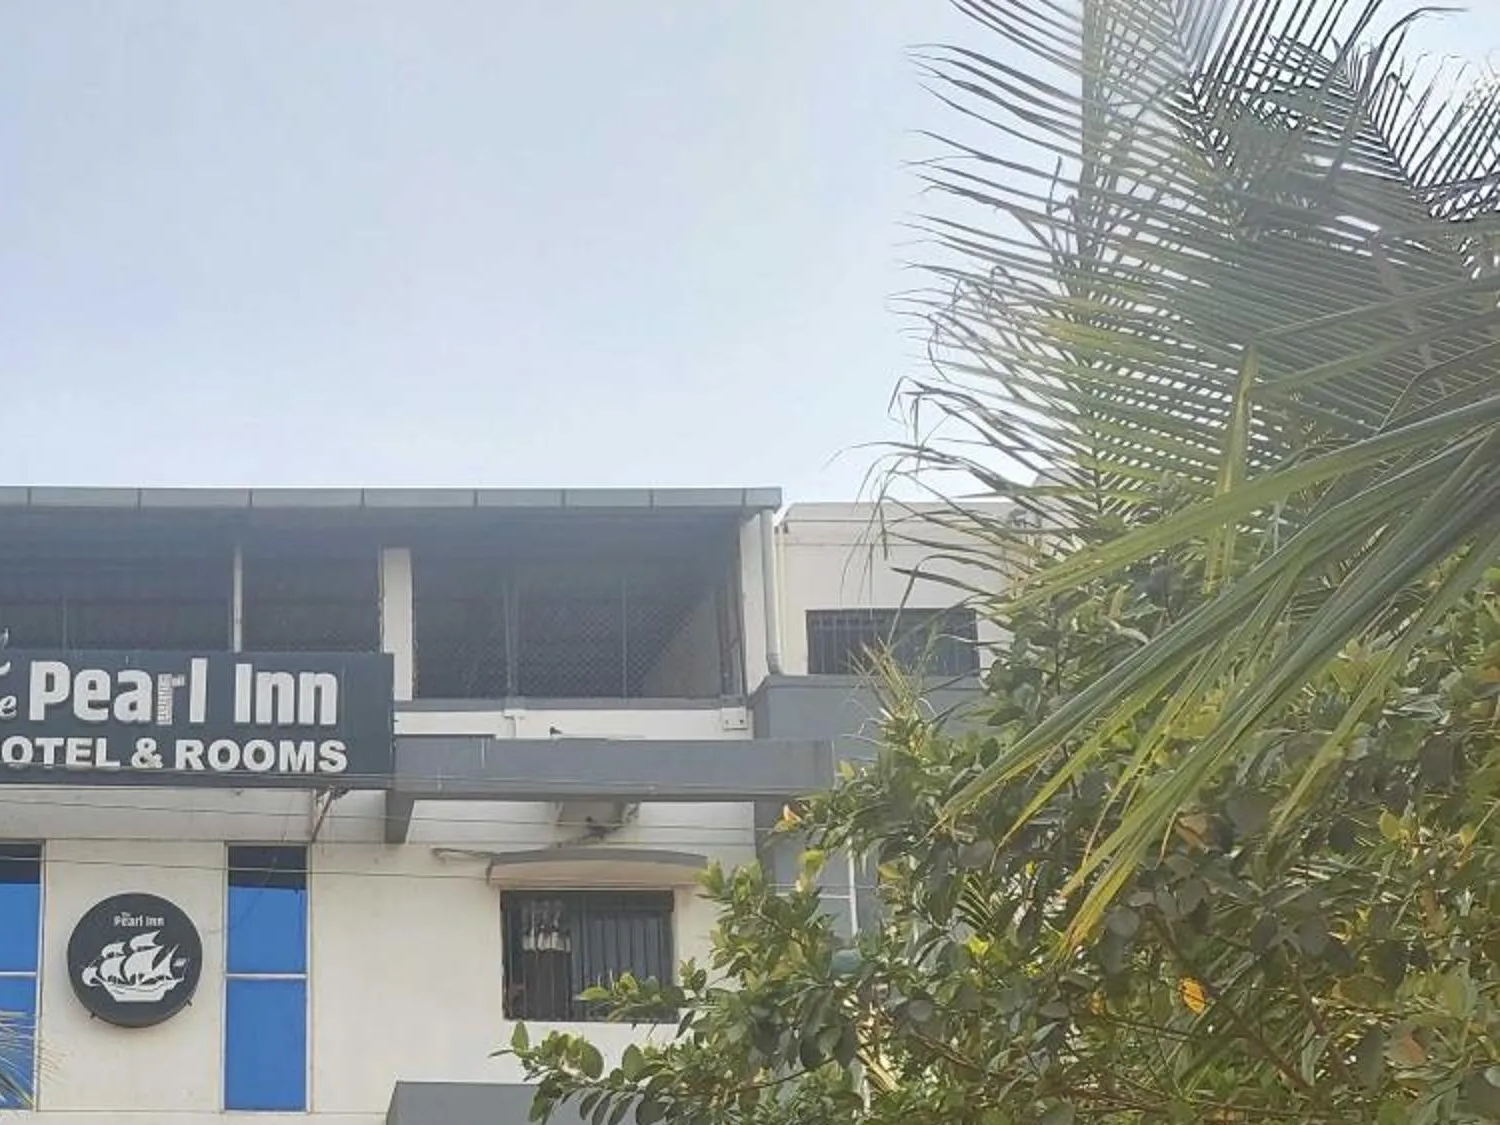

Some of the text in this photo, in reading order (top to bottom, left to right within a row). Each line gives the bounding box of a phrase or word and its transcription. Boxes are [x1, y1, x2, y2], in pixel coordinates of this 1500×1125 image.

[29, 657, 208, 726] Pearl
[234, 663, 339, 726] Inn
[131, 738, 163, 769] &
[175, 738, 349, 773] ROOMS
[113, 915, 143, 927] Pearl
